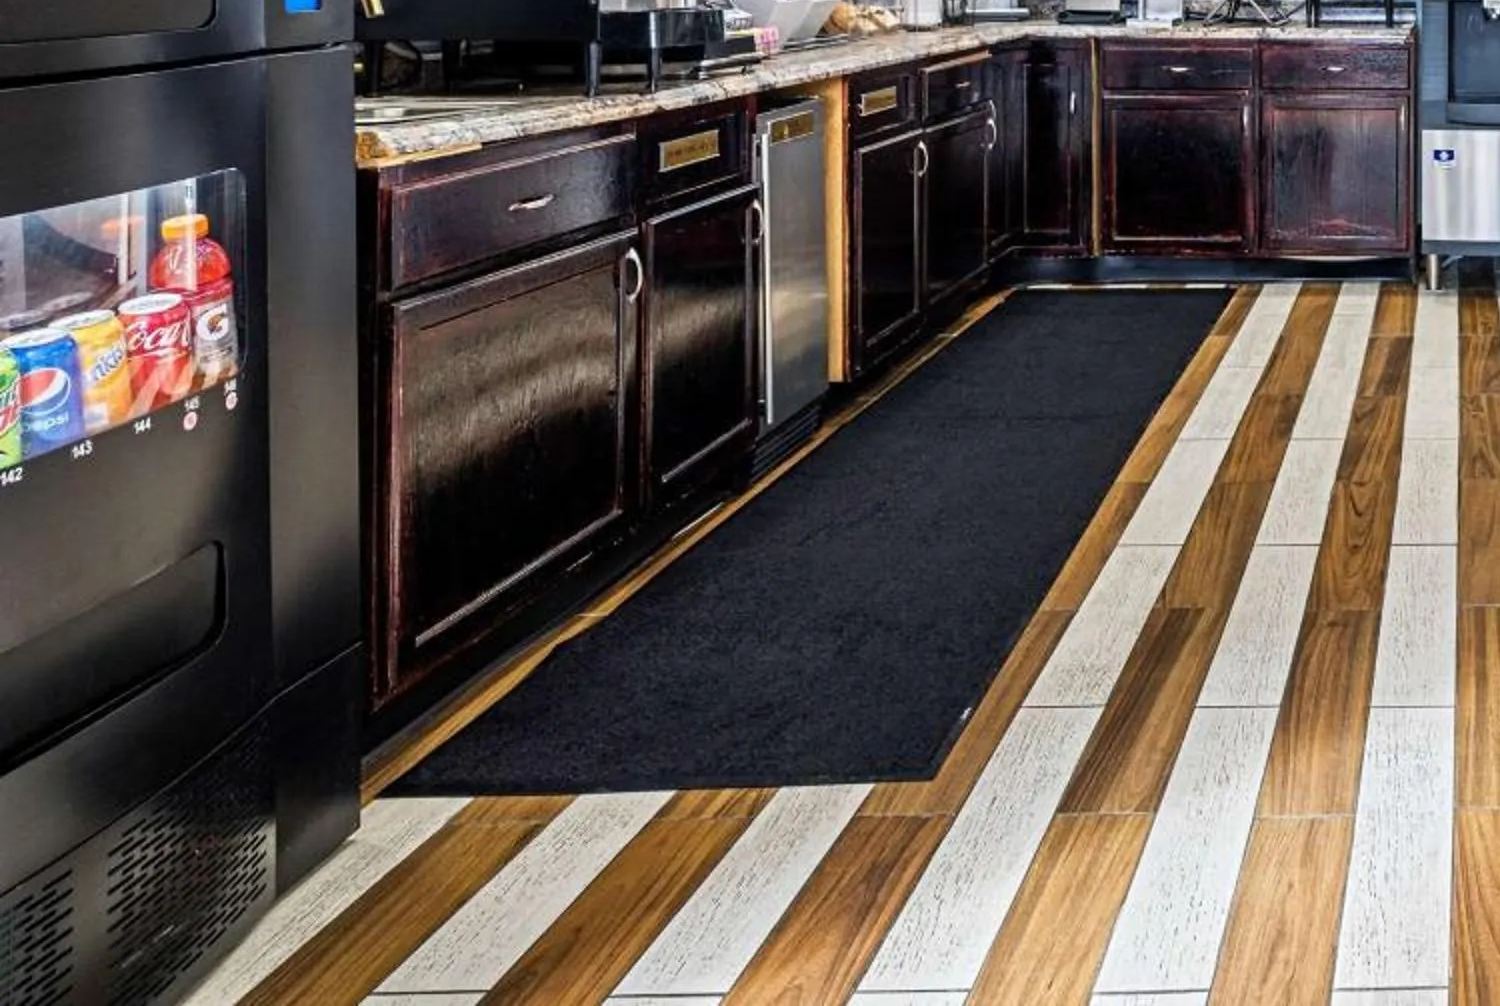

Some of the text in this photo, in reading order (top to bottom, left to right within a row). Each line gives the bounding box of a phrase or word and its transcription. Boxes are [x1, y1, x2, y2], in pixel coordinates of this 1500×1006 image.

[134, 417, 151, 435] 144
[72, 439, 94, 460] 143
[0, 467, 24, 486] 142
